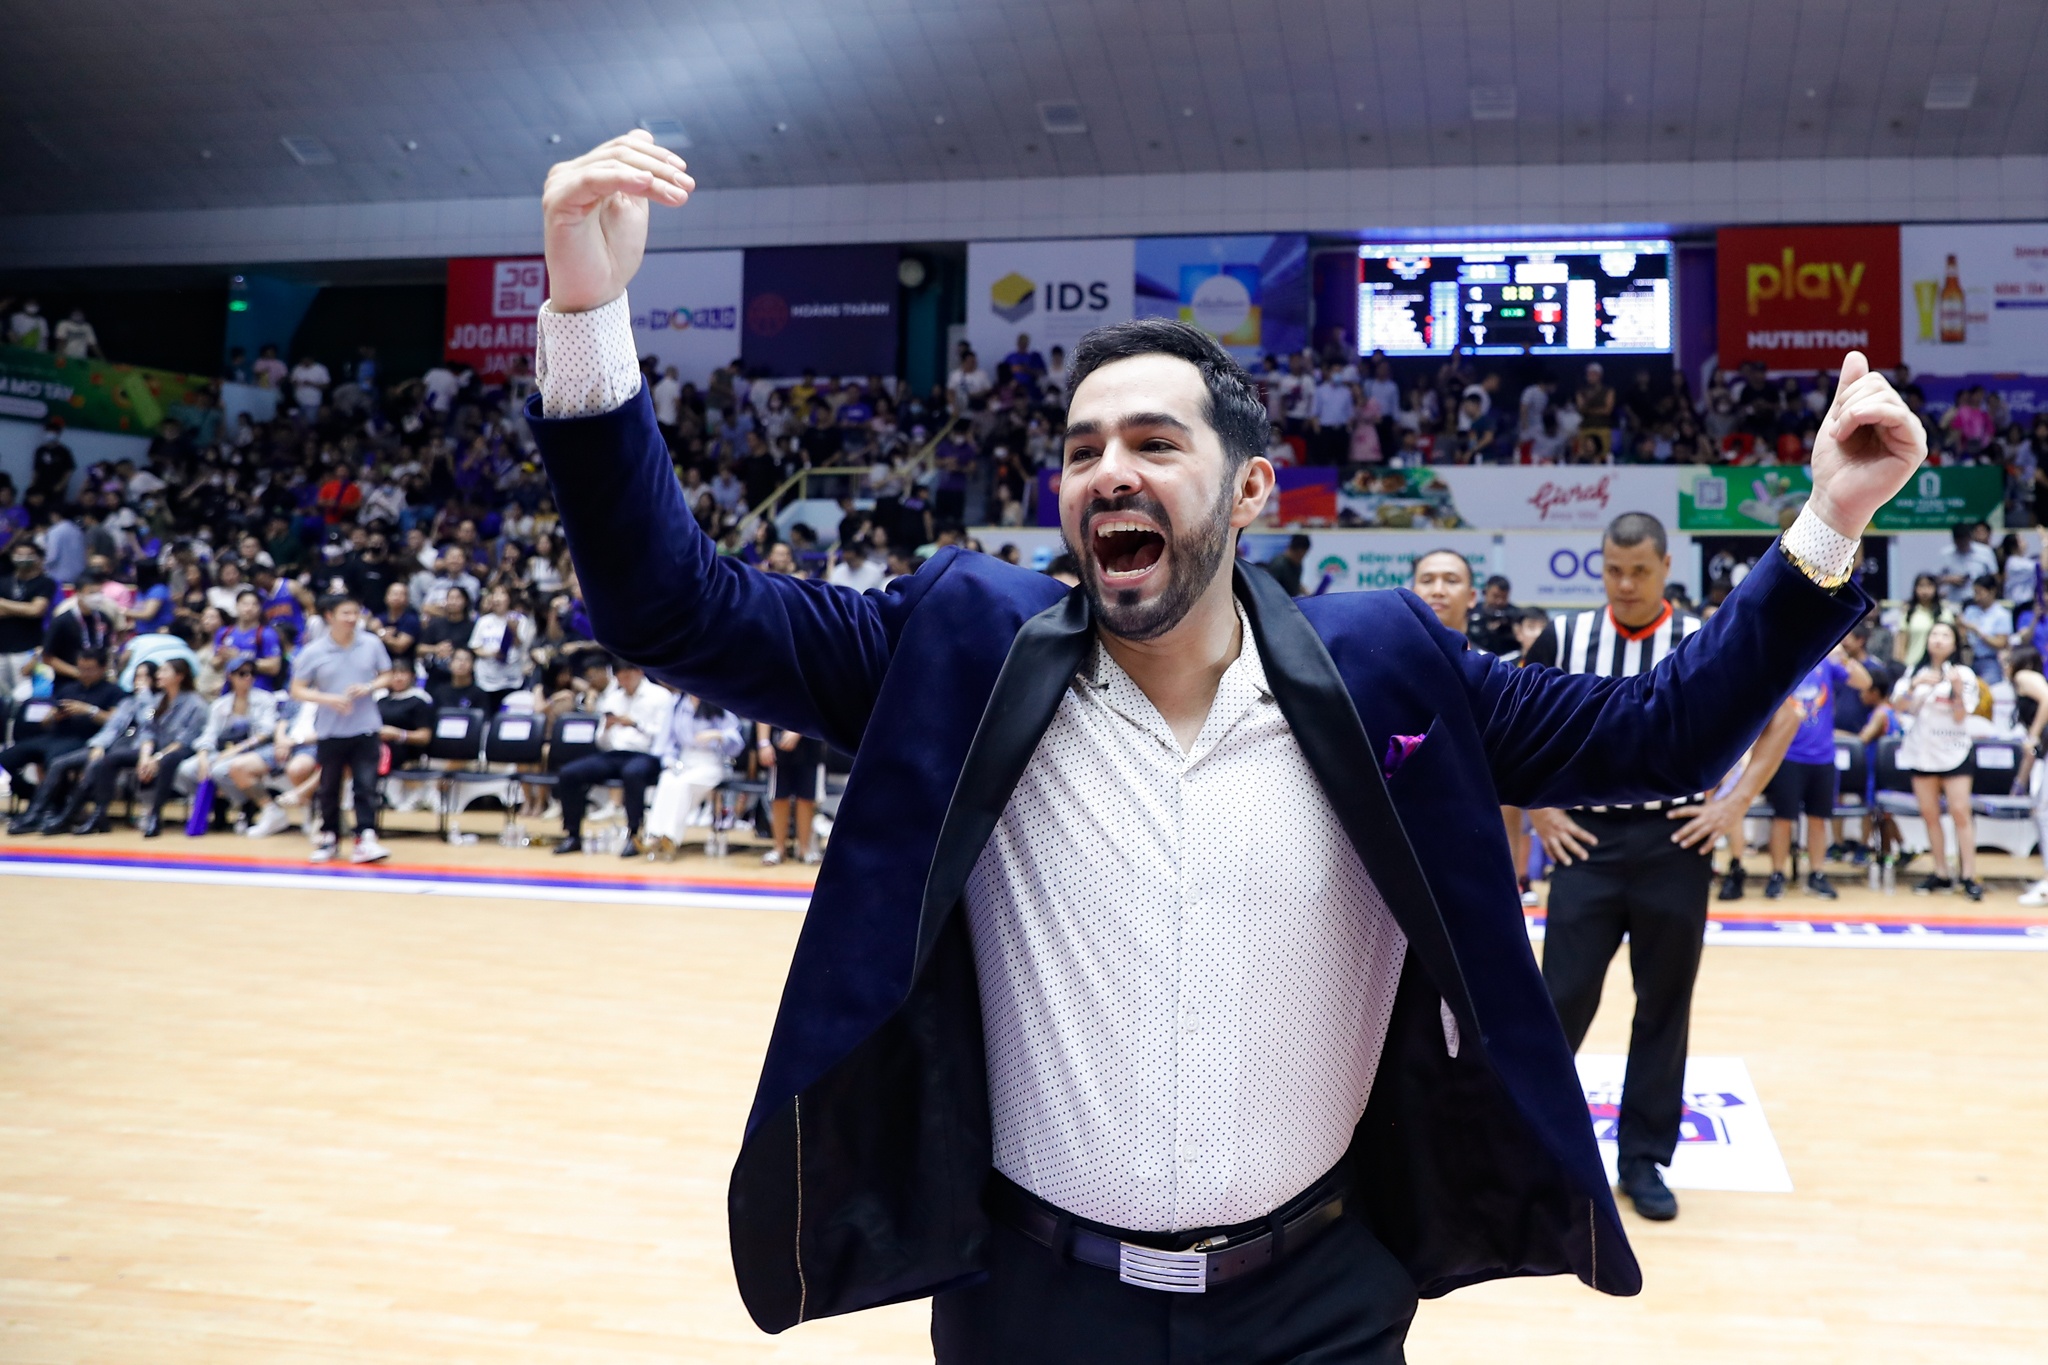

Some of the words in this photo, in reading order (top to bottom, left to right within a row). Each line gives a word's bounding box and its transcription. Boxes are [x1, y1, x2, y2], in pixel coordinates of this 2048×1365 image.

[1045, 281, 1110, 311] IDS
[1747, 247, 1865, 315] play
[1747, 330, 1868, 348] NUTRITION
